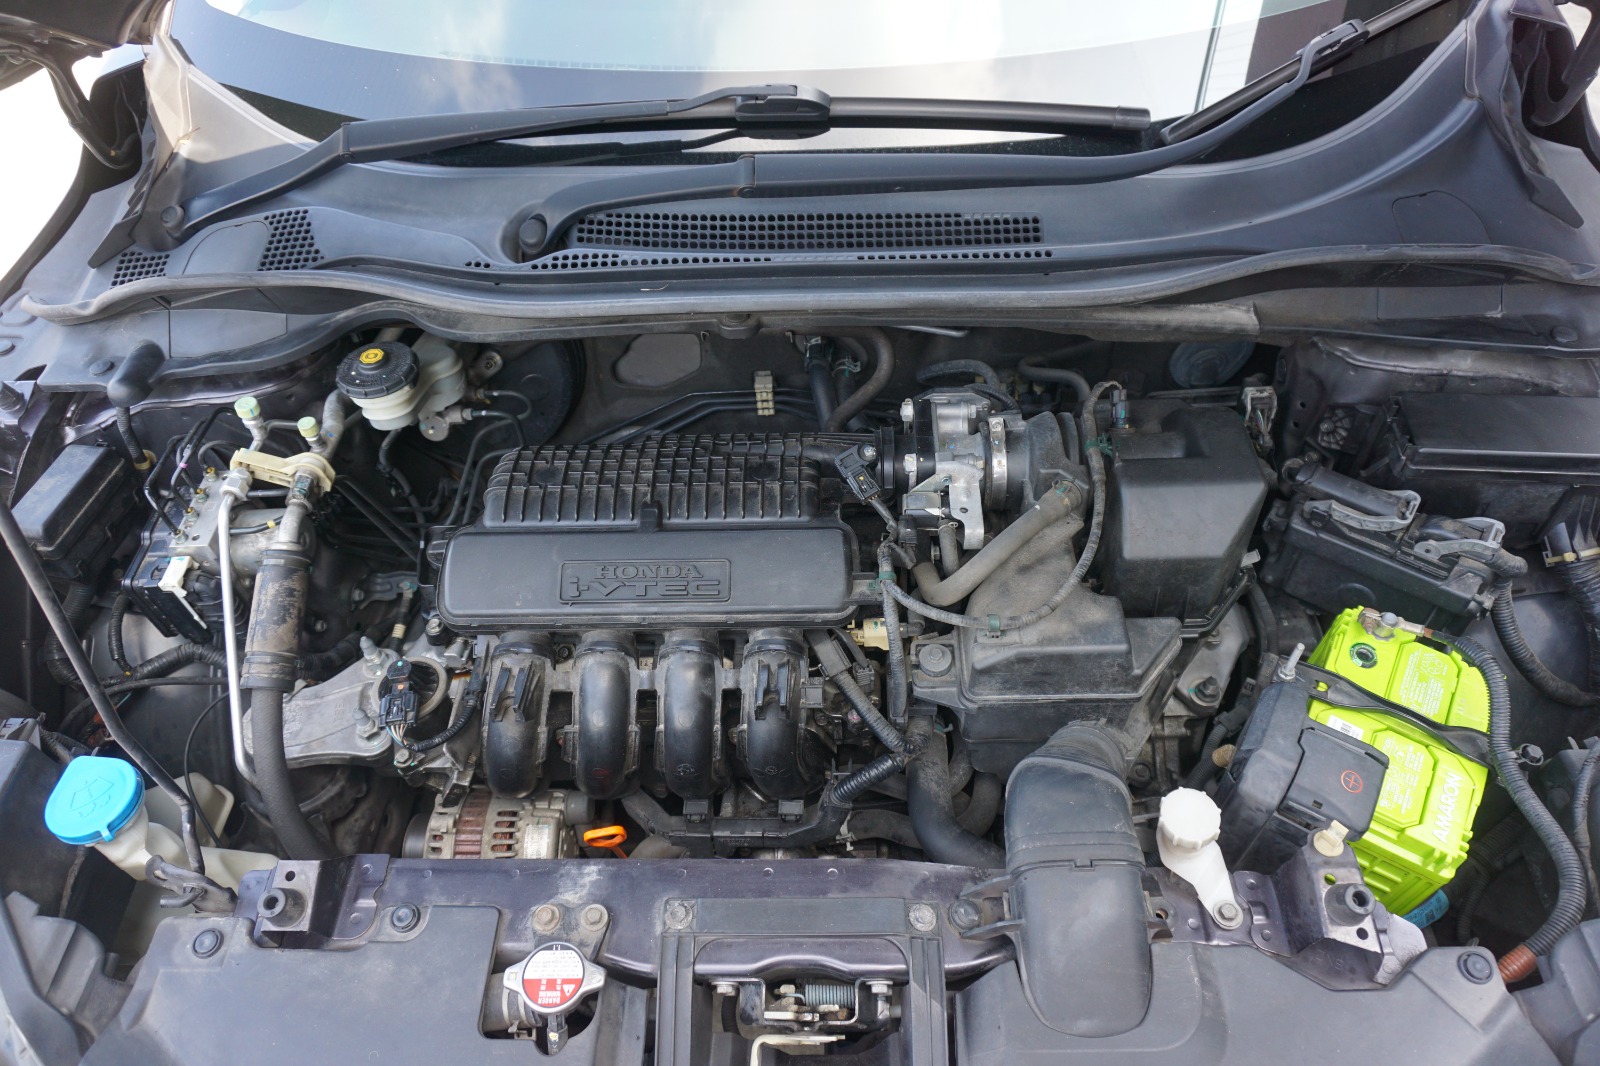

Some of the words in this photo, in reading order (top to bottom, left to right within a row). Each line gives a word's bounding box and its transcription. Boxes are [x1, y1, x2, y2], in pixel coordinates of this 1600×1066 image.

[593, 564, 703, 579] HONDA
[568, 577, 720, 597] i-VTEC
[1431, 773, 1463, 844] AMARON
